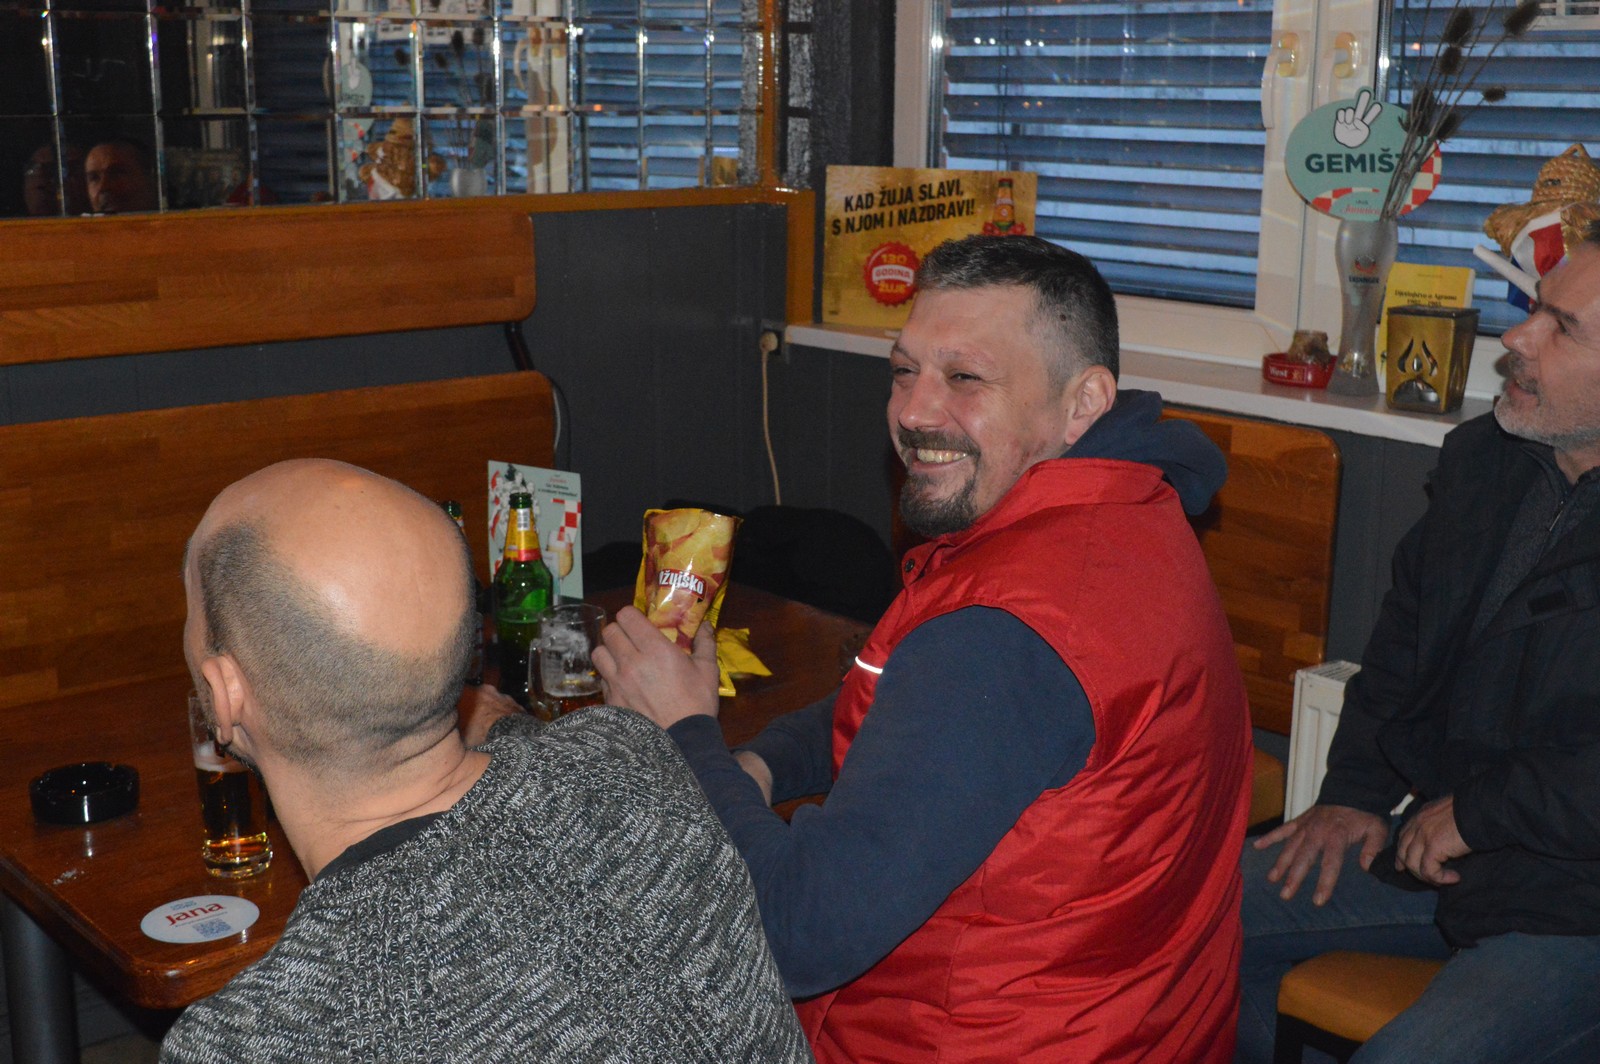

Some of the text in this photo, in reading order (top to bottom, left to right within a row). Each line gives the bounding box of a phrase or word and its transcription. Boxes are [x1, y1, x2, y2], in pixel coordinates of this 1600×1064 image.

[1305, 147, 1421, 173] GEMIŠ
[844, 178, 964, 213] KAD ŽUJA SLAVI,
[831, 219, 841, 235] S
[845, 213, 885, 234] NJOM
[888, 210, 894, 227] I
[897, 198, 975, 226] NAZDRAVI!
[875, 268, 910, 279] GODINA
[165, 903, 224, 926] Jana
